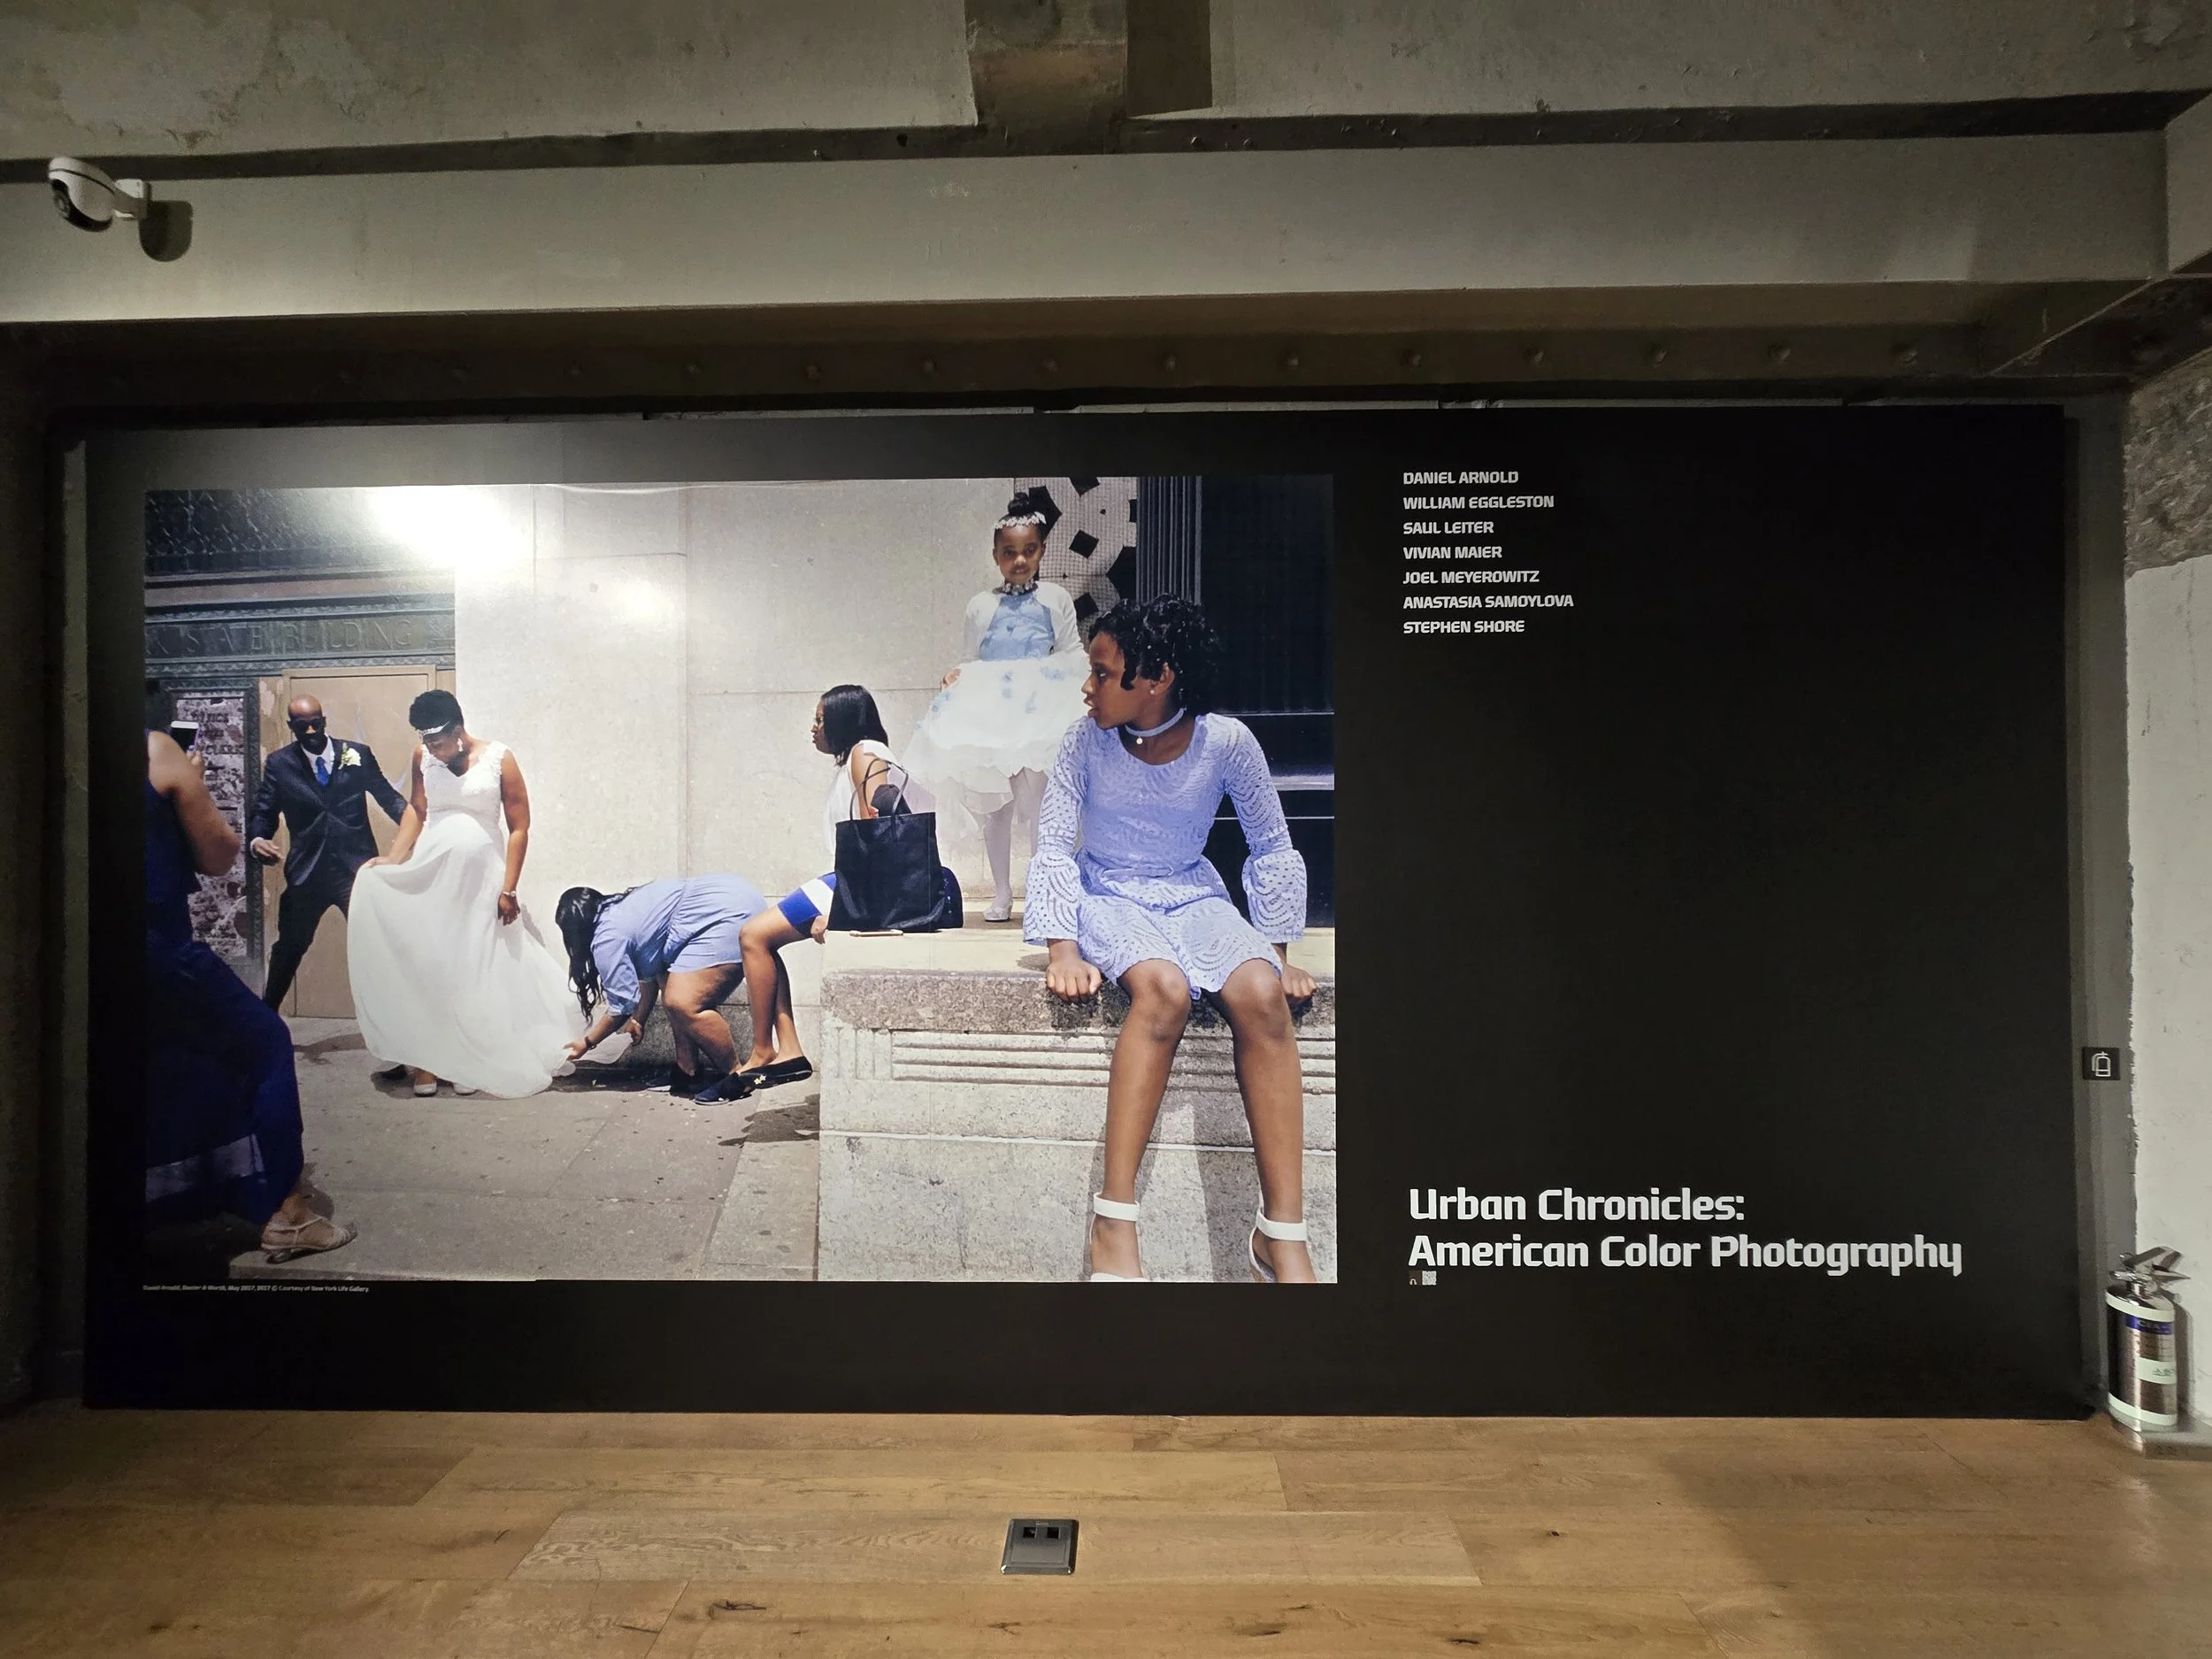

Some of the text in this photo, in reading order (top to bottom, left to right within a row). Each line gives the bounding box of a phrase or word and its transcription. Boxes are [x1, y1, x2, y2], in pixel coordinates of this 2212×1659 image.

[1402, 471, 1519, 485] DANIEL ARNOLD
[1402, 495, 1555, 510] WILLIAM EGGLESTON
[1402, 521, 1494, 534] SAUL LEITER
[1402, 546, 1502, 559] VIVIAN MAIER
[1402, 571, 1540, 584] JOEL MEYEROWITZ
[1402, 595, 1575, 609] ANASTASIA SAMOYLOVA
[1402, 620, 1525, 634] STEPHEN SHORE
[1409, 1187, 1745, 1221] Urban Chronicles:
[1408, 1234, 1962, 1277] American Color Photography
